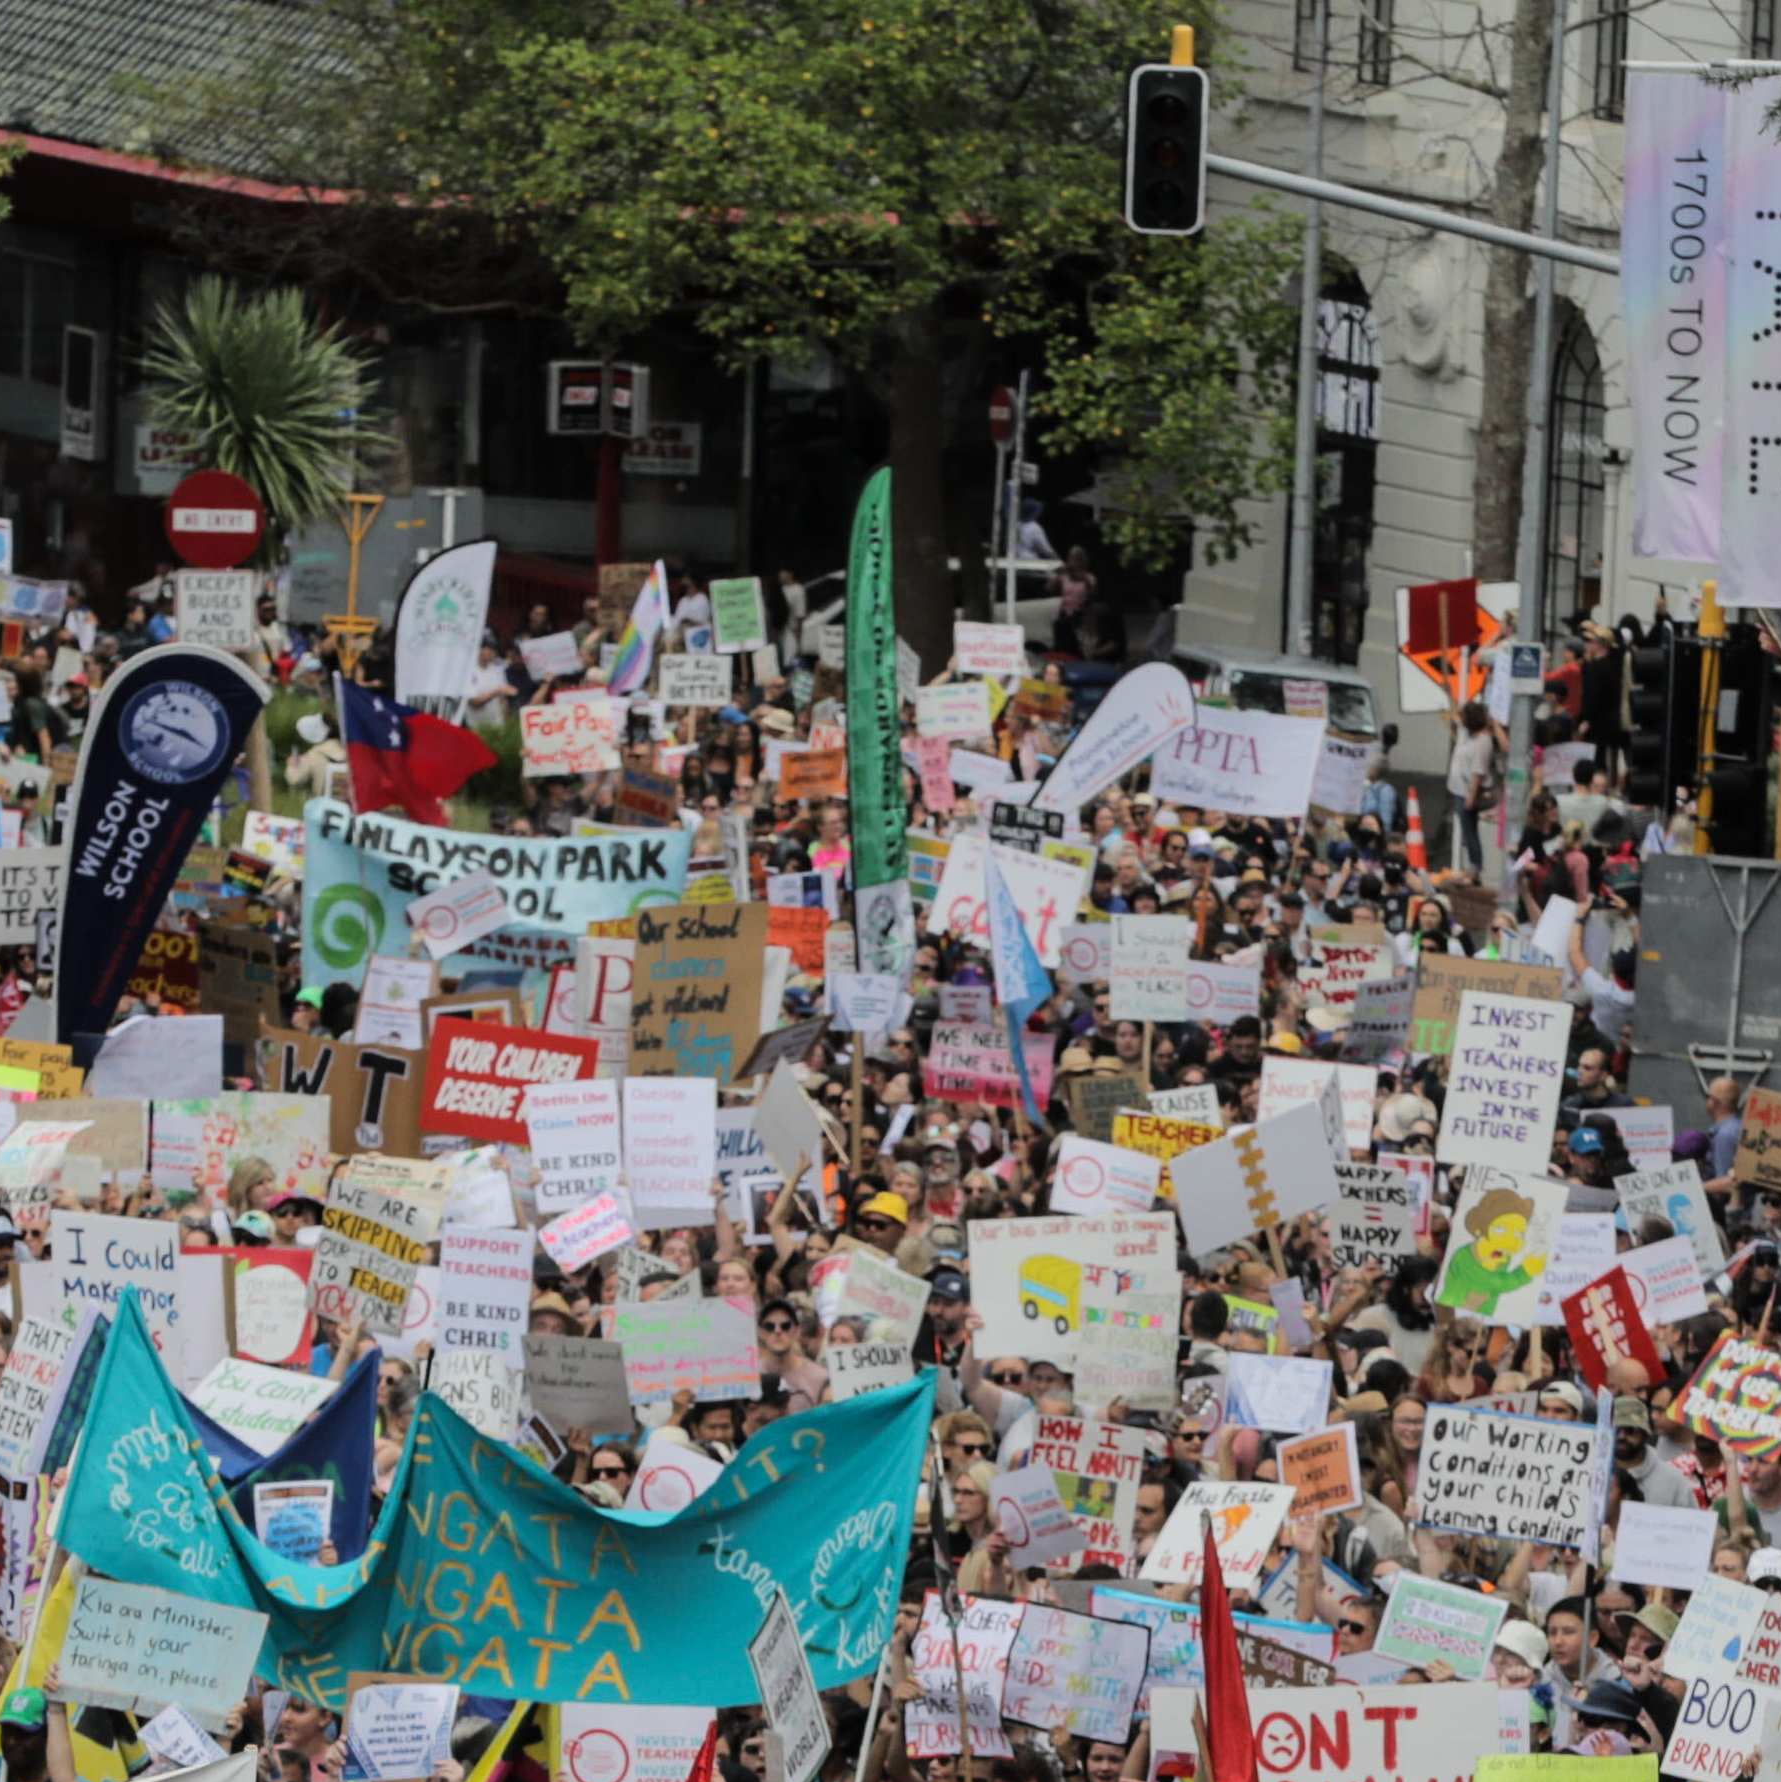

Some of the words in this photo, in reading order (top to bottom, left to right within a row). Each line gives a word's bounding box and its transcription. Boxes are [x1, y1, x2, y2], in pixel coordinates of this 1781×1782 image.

[1669, 148, 1709, 285] 1700s
[1666, 306, 1704, 359] TO
[1662, 373, 1702, 487] NOW
[199, 613, 233, 626] AND
[524, 710, 567, 738] Fair
[573, 704, 614, 742] Pay
[1172, 728, 1262, 775] PPTA
[76, 779, 139, 880] WILSON
[104, 794, 170, 901] SCHOOL
[320, 809, 547, 879] FINLAYSON
[557, 839, 667, 882] PARK
[386, 862, 564, 923] SCOL
[1471, 1004, 1554, 1031] INVEST
[1496, 1033, 1520, 1049] IN
[1462, 1049, 1558, 1078] TEACHERS
[1456, 1075, 1540, 1102] INVEST
[1451, 1116, 1528, 1143] FUTURE
[1478, 1101, 1506, 1118] IN
[1508, 1105, 1540, 1123] THE
[337, 1183, 366, 1209] WE
[380, 1197, 418, 1226] ARE
[322, 1206, 426, 1264] SKIPPING
[445, 1234, 522, 1255] SUPPORT
[319, 1261, 338, 1281] TO
[349, 1266, 406, 1305] TEACH
[445, 1260, 531, 1282] TEACHERS
[314, 1281, 357, 1311] YOU
[361, 1298, 398, 1327] ONE
[446, 1301, 468, 1317] BE
[475, 1304, 521, 1322] KIND
[79, 1583, 112, 1614] Kia
[68, 1617, 135, 1646] Switch
[144, 1637, 192, 1658] your
[70, 1645, 129, 1679] taringa
[169, 1667, 218, 1690] please
[1683, 1678, 1755, 1733] BOO
